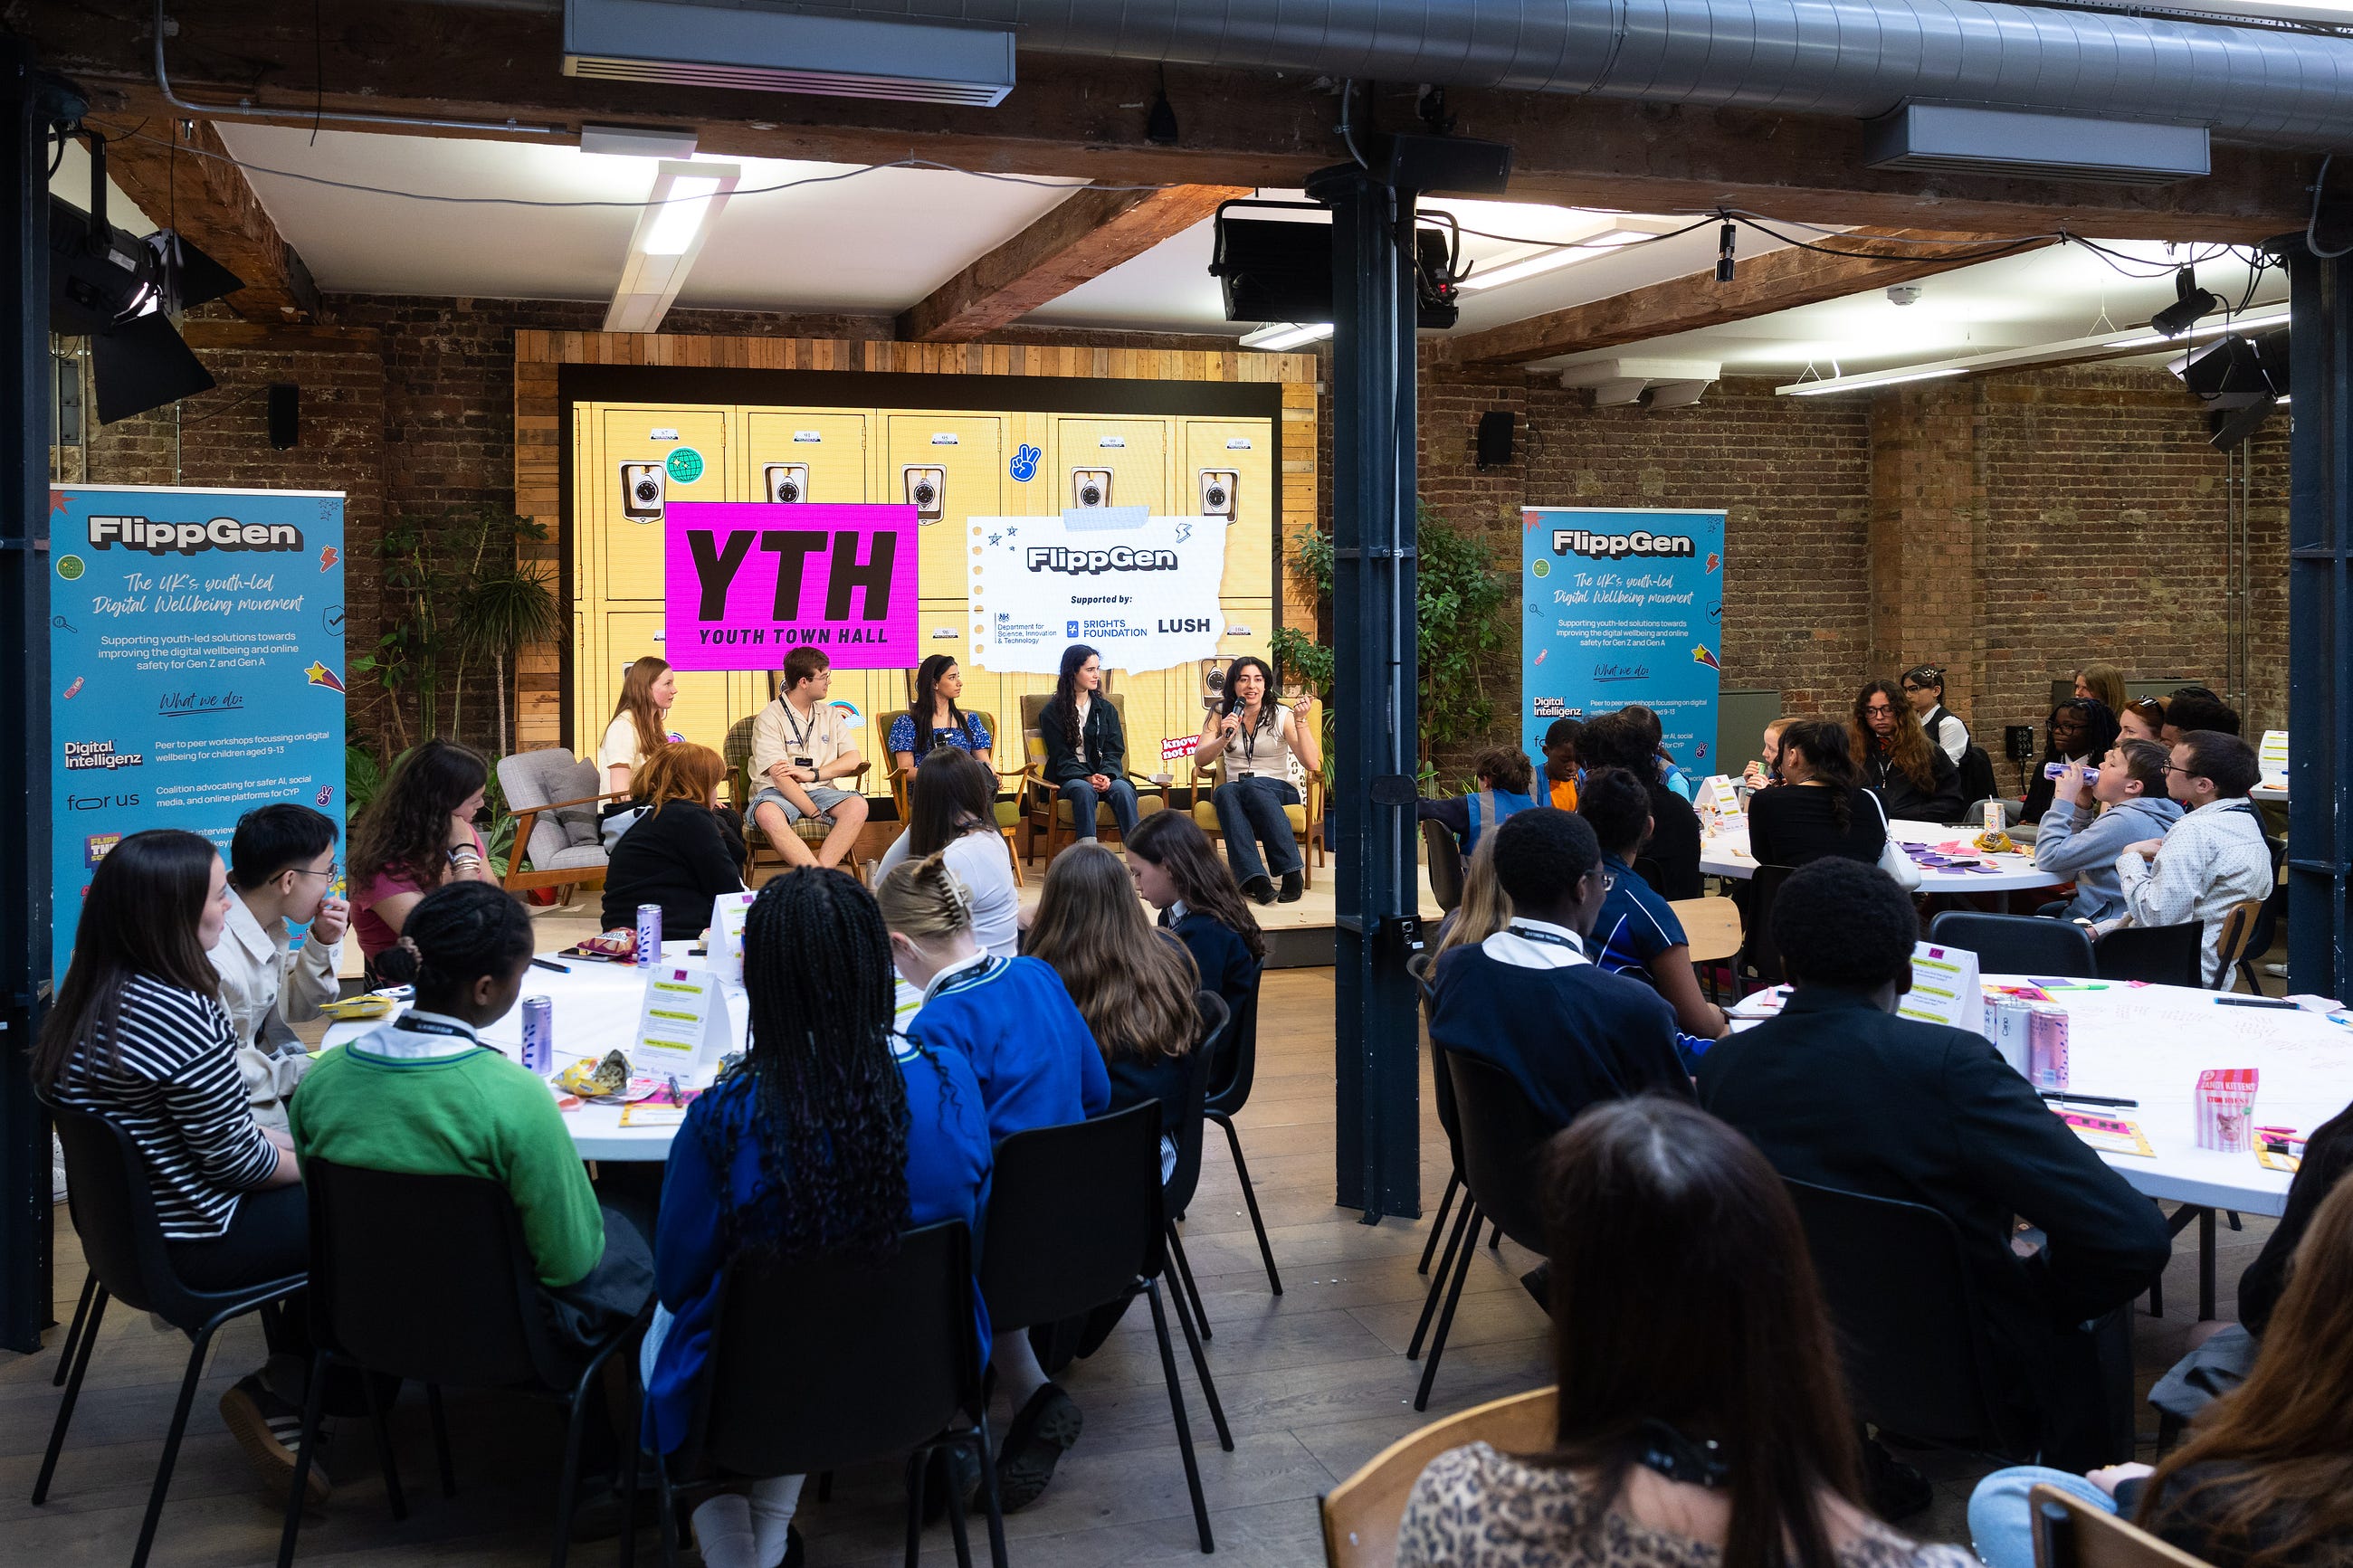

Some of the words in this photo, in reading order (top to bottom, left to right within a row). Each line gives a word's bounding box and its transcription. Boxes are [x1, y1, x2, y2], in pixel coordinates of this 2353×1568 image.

[88, 516, 300, 553] FlippGen
[1553, 530, 1692, 558] FlippGen
[1027, 546, 1177, 575] FlippGen
[686, 529, 897, 621] YTH
[1573, 573, 1592, 587] The
[1597, 573, 1623, 587] UK's
[1626, 574, 1674, 588] youth-led
[123, 573, 152, 592] The
[159, 574, 199, 590] UK's
[205, 574, 274, 592] youth-led
[1071, 594, 1116, 605] Supported
[1118, 594, 1132, 605] by:
[1554, 590, 1588, 606] Digital
[1593, 590, 1645, 606] Wellbeing
[1648, 592, 1694, 604] movement
[92, 595, 148, 617] Digital
[155, 595, 234, 615] Wellbeing
[237, 594, 304, 612] movement
[1083, 620, 1126, 628] 5RIGHTS
[1157, 619, 1210, 632] LUSH
[1558, 620, 1596, 628] Supporting
[1597, 620, 1628, 628] youth-led
[101, 635, 159, 645] Supporting
[160, 634, 210, 644] youth-led
[211, 632, 255, 642] solutions
[258, 632, 296, 641] towards
[700, 629, 765, 645] YOUTH
[773, 629, 829, 644] TOWN
[838, 628, 888, 643] HALL
[1083, 629, 1148, 638] FOUNDATION
[1557, 629, 1589, 638] improving
[1602, 630, 1623, 638] digital
[1624, 630, 1655, 638] wellbeing
[99, 648, 149, 660] improving
[151, 647, 168, 656] the
[170, 646, 202, 658] digital
[203, 644, 250, 657] wellbeing
[252, 644, 269, 653] and
[270, 643, 299, 653] online
[137, 660, 168, 671] safety
[170, 659, 184, 669] for
[186, 659, 207, 668] Gen
[209, 659, 216, 668] Z
[218, 658, 235, 667] and
[237, 658, 257, 667] Gen
[259, 657, 266, 666] A
[1594, 664, 1617, 676] What
[1619, 666, 1632, 675] we
[1634, 665, 1649, 676] do:
[159, 692, 196, 709] What
[199, 695, 218, 707] we
[223, 690, 243, 707] do:
[1533, 697, 1565, 708] Digital
[1533, 707, 1582, 718] Intelligenz
[155, 740, 176, 749] Peer
[177, 740, 186, 748] to
[187, 738, 207, 749] peer
[208, 736, 253, 748] workshops
[254, 734, 292, 746] focussing
[305, 731, 329, 742] digital
[1162, 736, 1199, 749] know
[64, 740, 115, 756] Digital
[156, 751, 196, 763] wellbeing
[198, 750, 210, 759] for
[211, 748, 245, 758] children
[246, 747, 266, 757] aged
[267, 746, 284, 755] 9-13
[1162, 747, 1185, 759] not
[65, 753, 143, 769] Intelligenz
[156, 784, 195, 794] Coalition
[195, 782, 243, 794] advocating
[244, 780, 255, 788] for
[256, 778, 276, 787] safer
[289, 774, 311, 784] social
[117, 794, 139, 806] us
[157, 797, 184, 808] media,
[185, 795, 203, 805] and
[205, 794, 231, 803] online
[232, 791, 270, 803] platforms
[271, 789, 281, 797] for
[283, 788, 300, 797] CYP
[195, 827, 236, 836] interview
[214, 840, 228, 848] key
[2225, 1082, 2255, 1090] KITTENS
